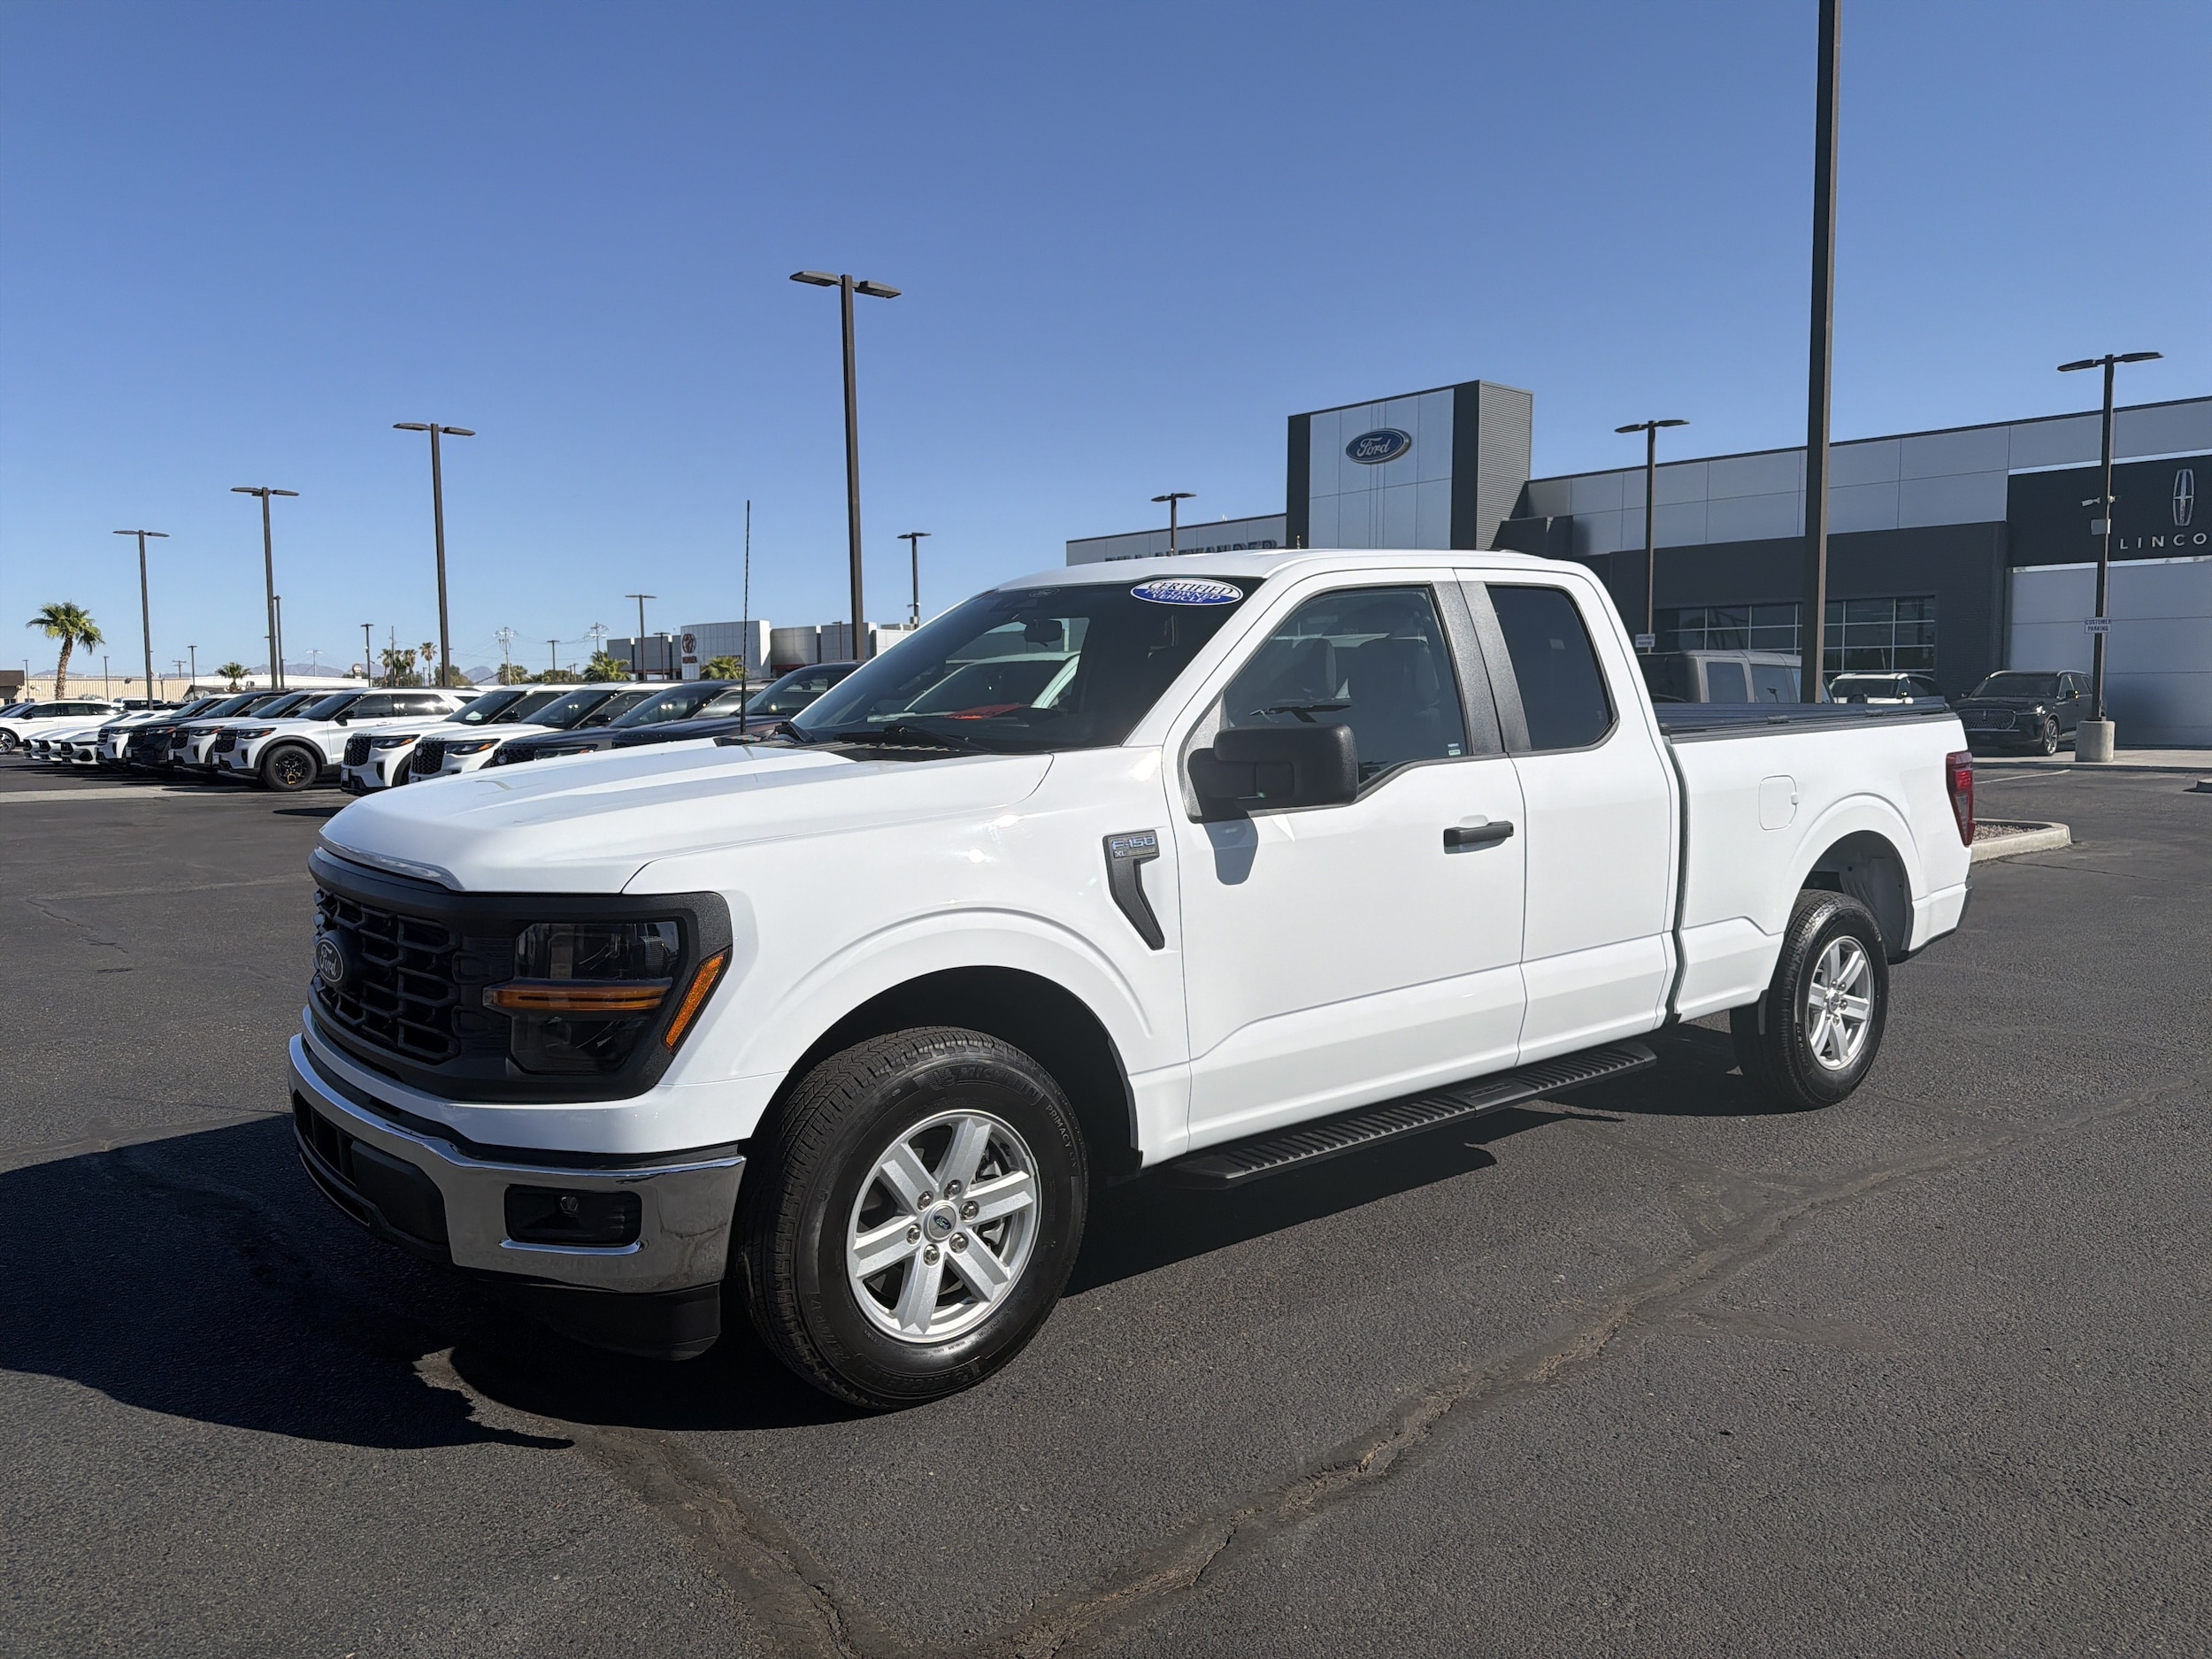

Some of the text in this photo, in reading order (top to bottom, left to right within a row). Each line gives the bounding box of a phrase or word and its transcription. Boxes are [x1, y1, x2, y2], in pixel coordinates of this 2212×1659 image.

[1356, 437, 1392, 457] Ford
[2119, 533, 2208, 549] LINCO
[1144, 588, 1221, 601] PRE-OWNED
[1148, 581, 1233, 595] CERTIFIED
[1151, 593, 1205, 603] VEHICLE
[1112, 836, 1156, 850] F-150
[319, 943, 337, 977] Ford
[1045, 1103, 1072, 1148] PRIMACY
